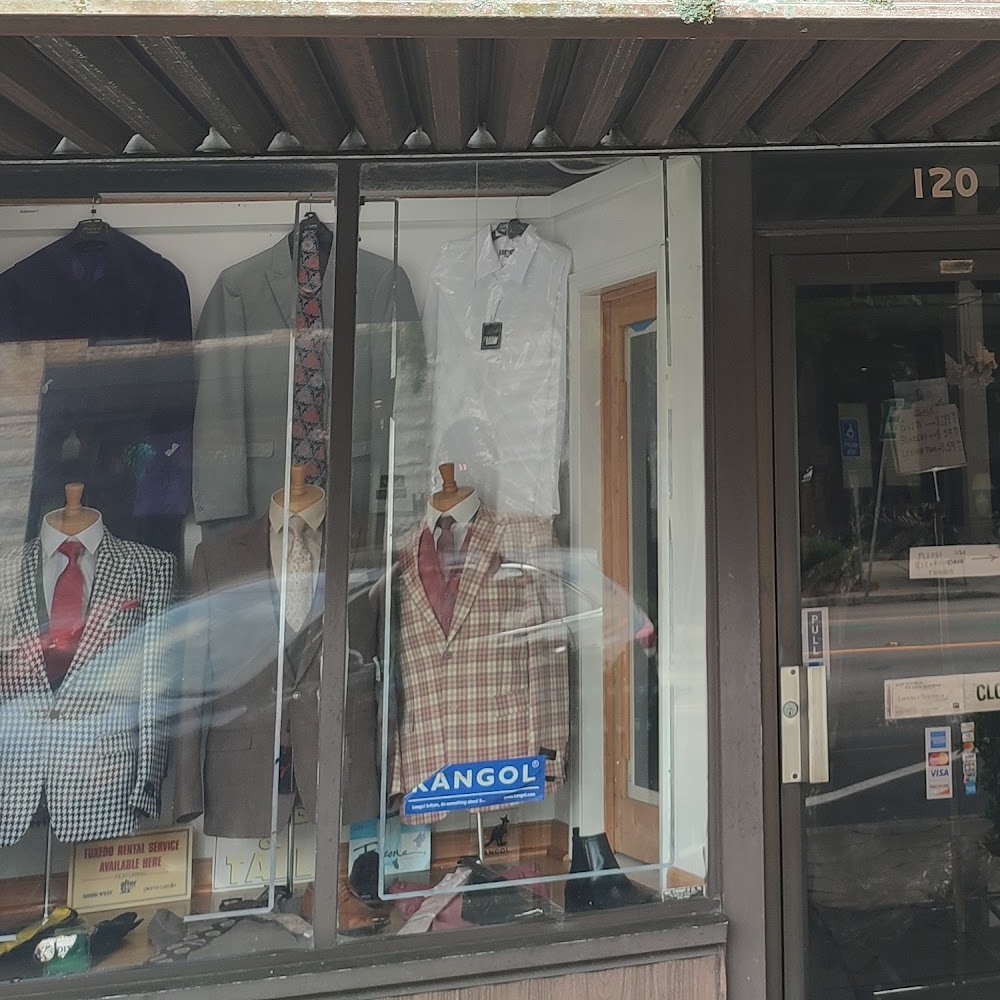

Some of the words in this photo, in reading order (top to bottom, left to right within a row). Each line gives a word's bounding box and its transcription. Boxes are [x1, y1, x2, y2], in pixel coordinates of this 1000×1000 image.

[913, 167, 979, 199] 120
[918, 551, 943, 559] PLEASE
[811, 614, 819, 656] PULL
[930, 768, 950, 778] VISA
[84, 845, 114, 859] TUXEDO
[117, 843, 145, 855] RENTAL
[148, 839, 180, 853] SERVICE
[99, 857, 140, 873] AVAILABLE
[142, 856, 163, 869] HERE
